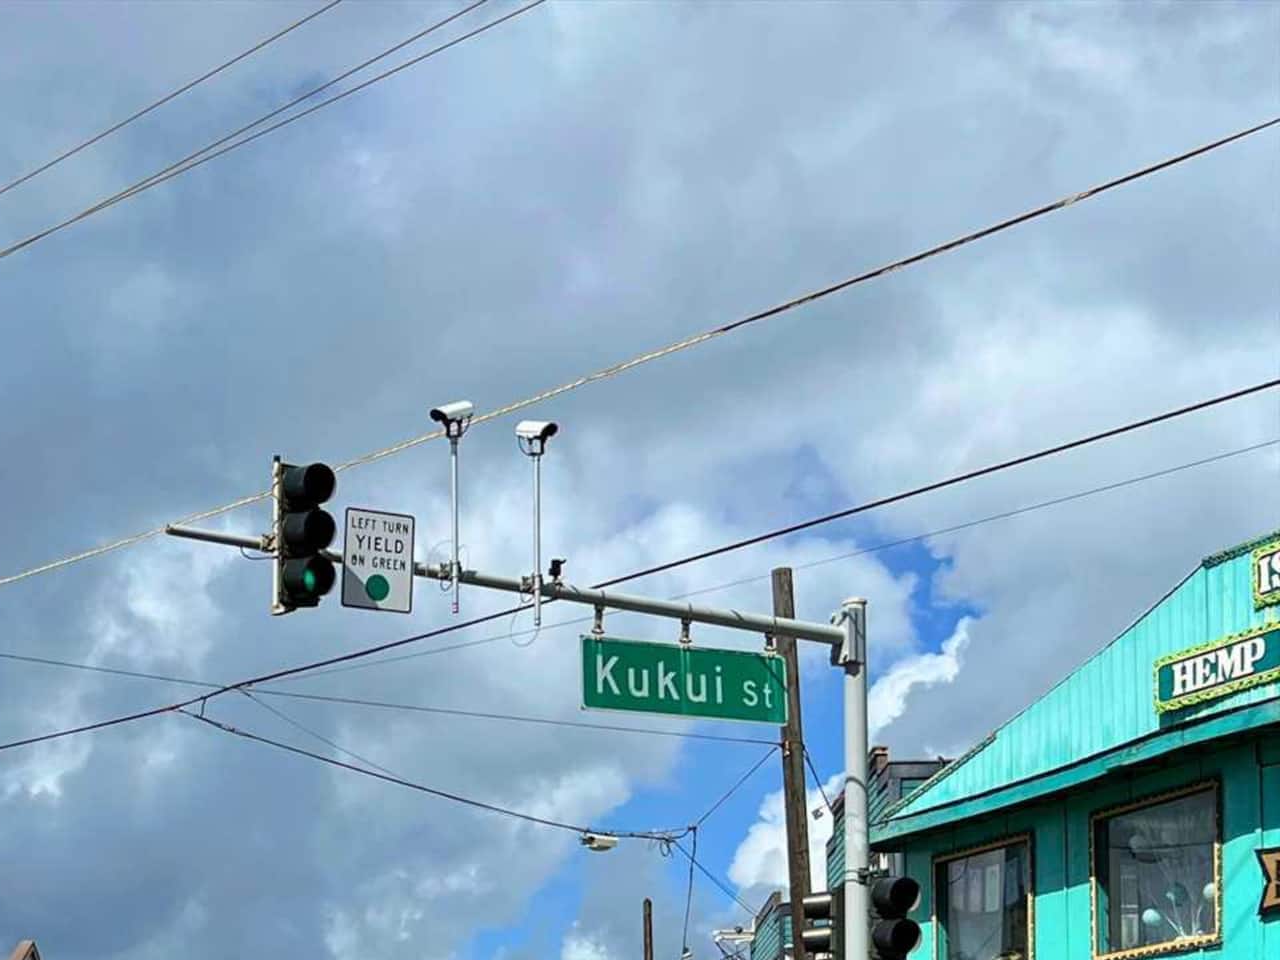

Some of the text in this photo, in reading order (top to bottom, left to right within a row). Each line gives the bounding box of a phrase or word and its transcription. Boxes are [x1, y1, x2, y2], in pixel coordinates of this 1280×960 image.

[351, 516, 409, 534] LEFT TURN
[356, 534, 404, 554] YIELD
[351, 554, 406, 571] ON GREEN
[1171, 636, 1266, 697] HEMP
[595, 654, 773, 709] Kukui St
